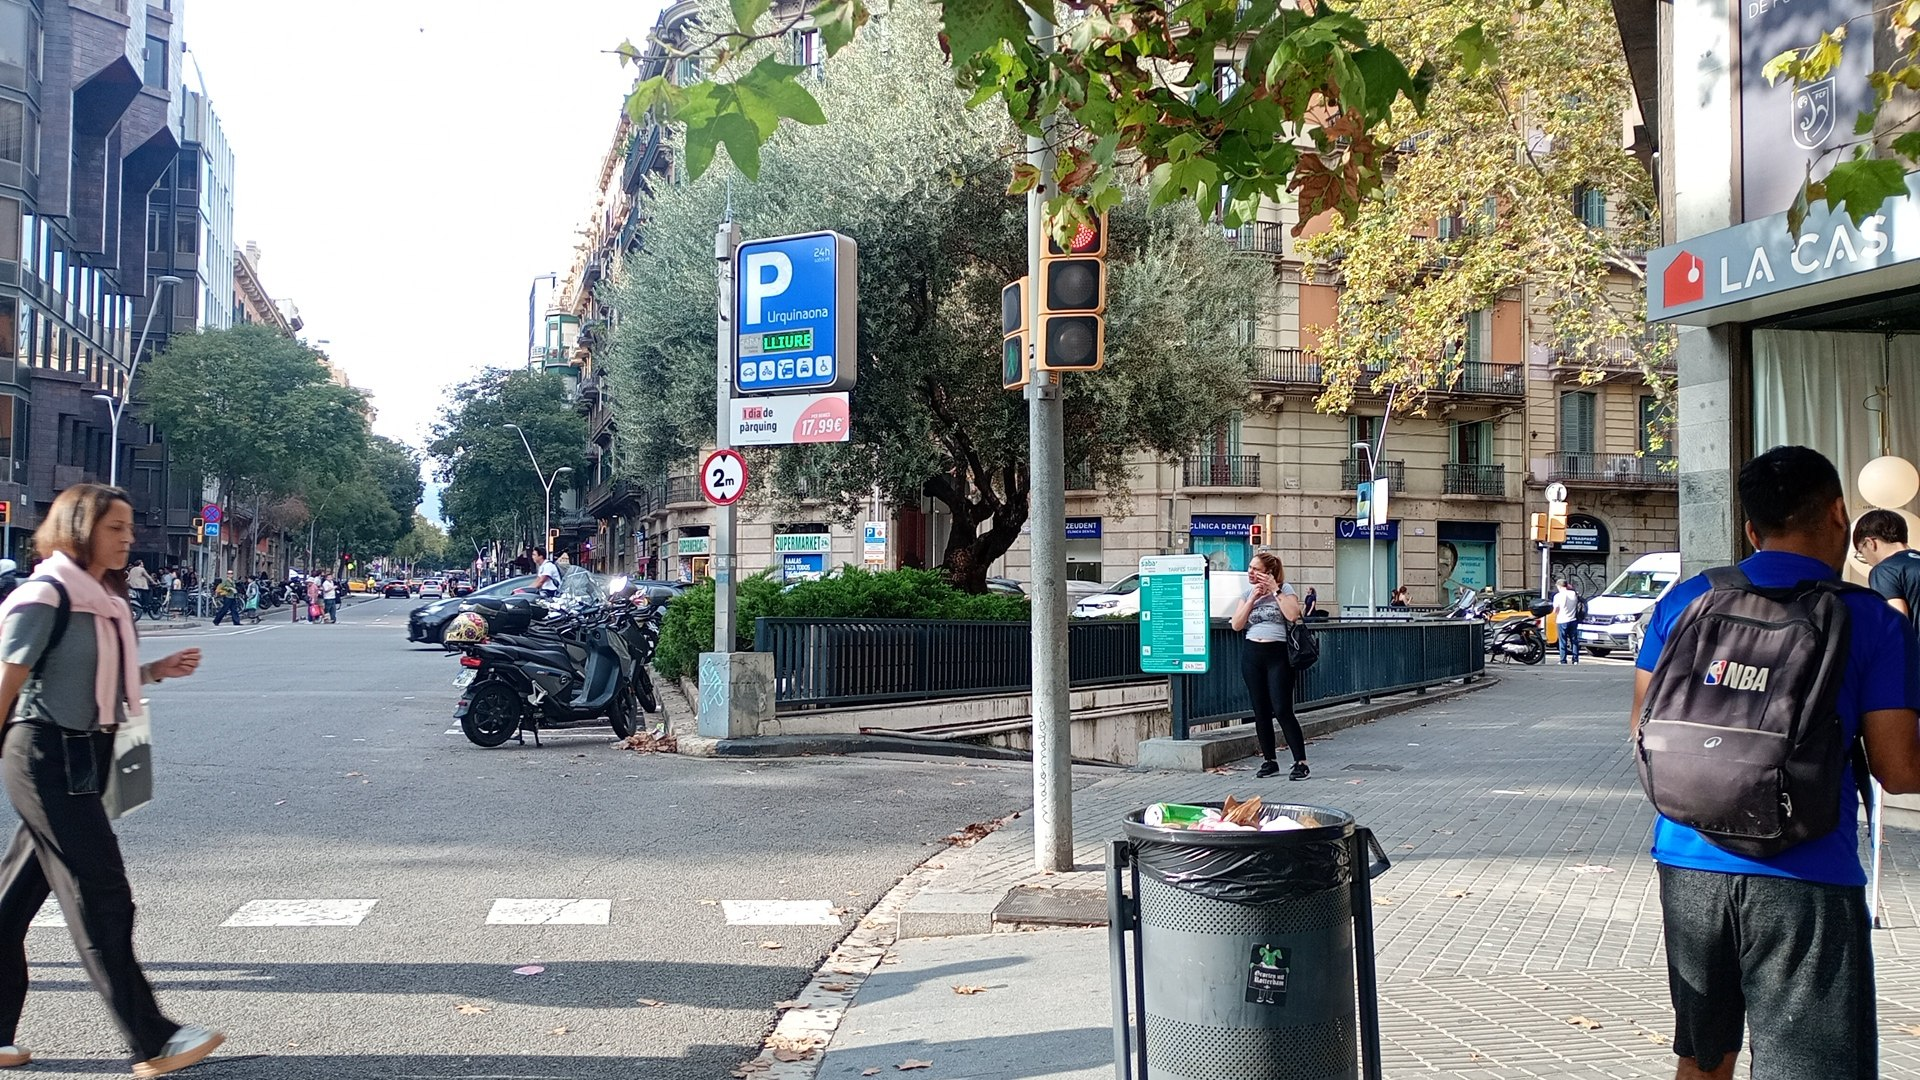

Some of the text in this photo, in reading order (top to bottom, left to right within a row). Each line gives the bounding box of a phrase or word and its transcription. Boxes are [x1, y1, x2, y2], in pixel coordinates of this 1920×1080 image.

[1749, 0, 1768, 18] DE
[813, 247, 831, 258] 24h
[1720, 210, 1914, 294] LA CAS
[746, 251, 793, 325] P
[767, 308, 828, 325] Urquinaona
[763, 334, 811, 350] LLIURE
[763, 407, 773, 418] de
[739, 421, 777, 434] pàrquing
[1065, 522, 1097, 530] ZEUDENT
[776, 536, 821, 551] SUPERMARKET
[1722, 661, 1770, 692] NBA
